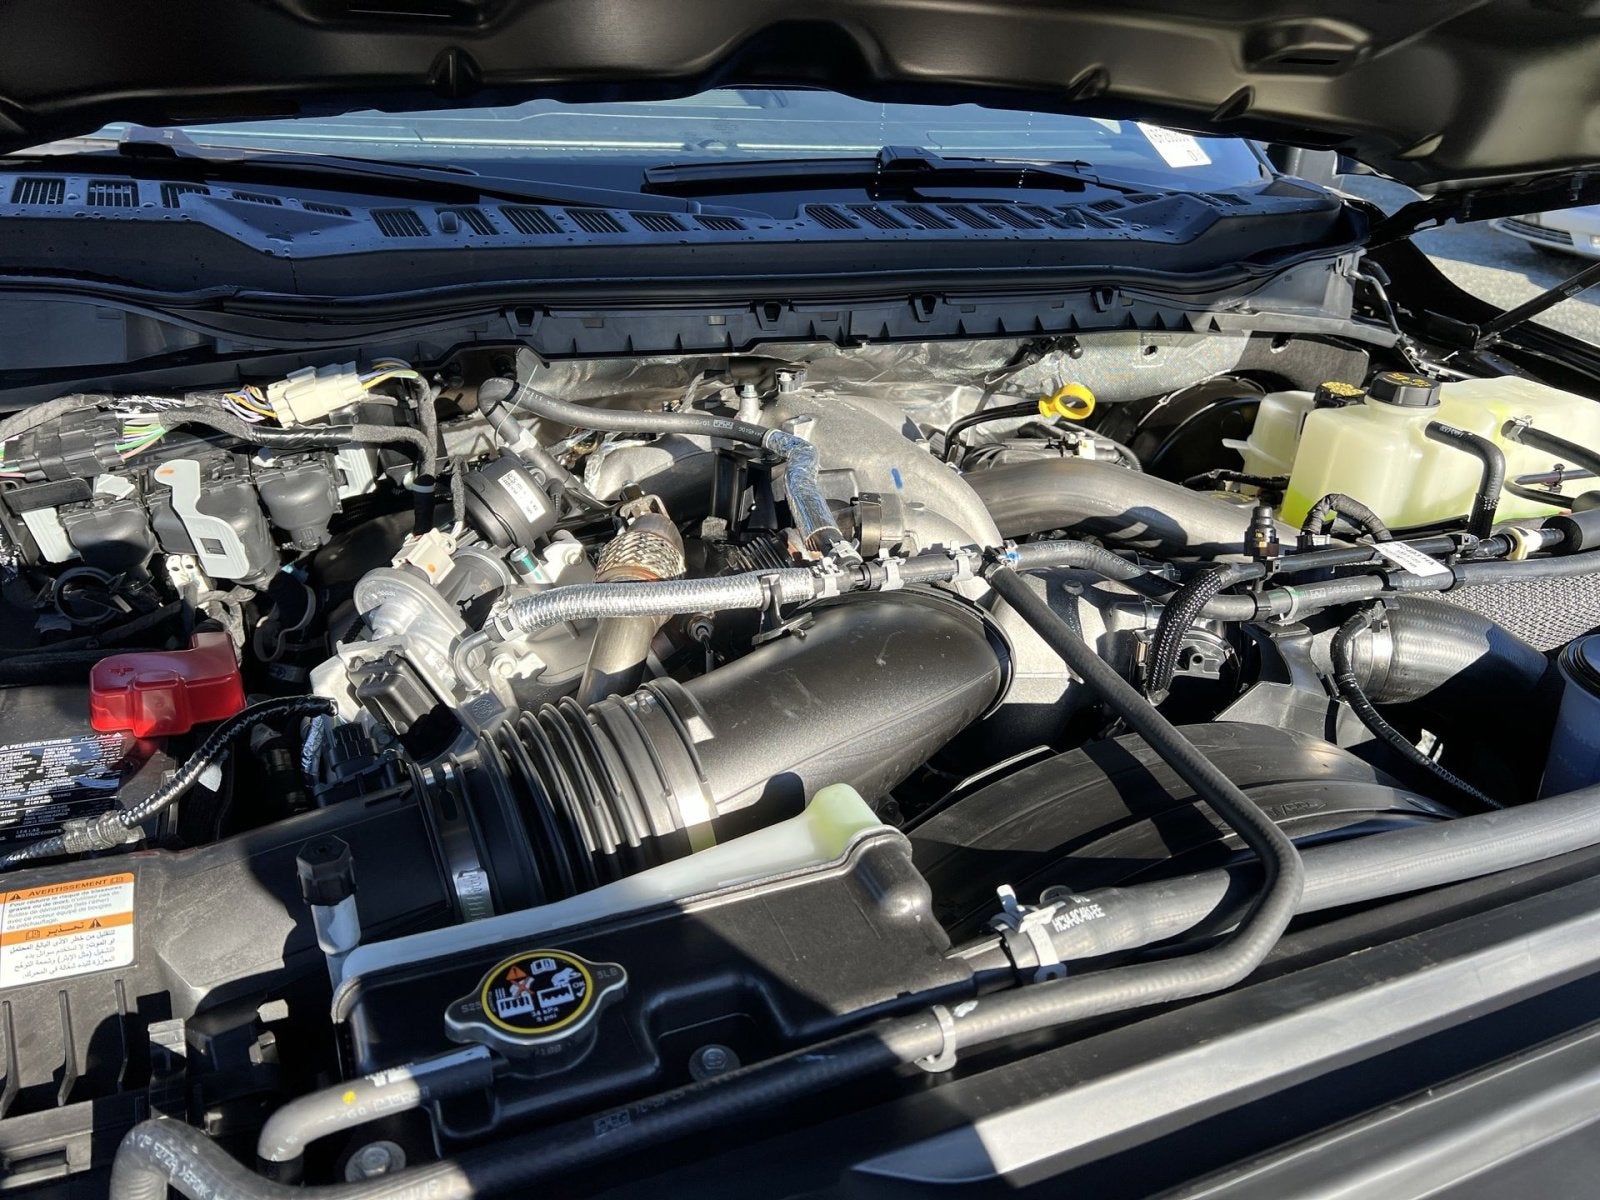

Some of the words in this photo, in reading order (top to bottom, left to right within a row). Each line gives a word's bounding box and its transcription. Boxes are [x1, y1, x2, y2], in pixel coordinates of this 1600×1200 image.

[28, 879, 107, 897] AVERTISSEMENT
[543, 1007, 559, 1015] kPa
[544, 1013, 558, 1022] psi
